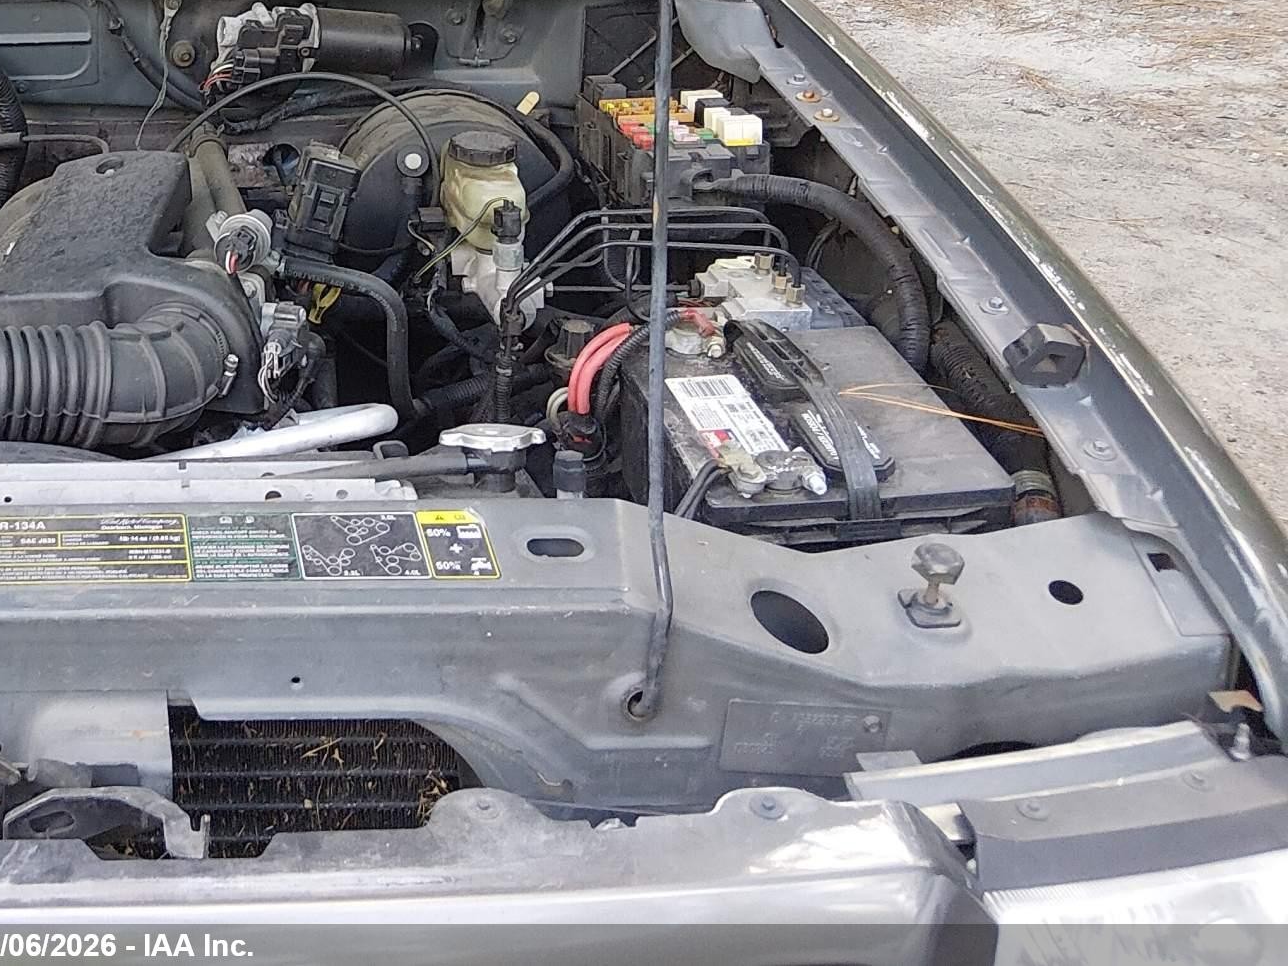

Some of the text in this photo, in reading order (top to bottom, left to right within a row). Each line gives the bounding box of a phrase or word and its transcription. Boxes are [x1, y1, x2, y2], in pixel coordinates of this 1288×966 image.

[0, 520, 46, 531] R-134A
[425, 527, 452, 537] 50%
[435, 560, 462, 570] 50%
